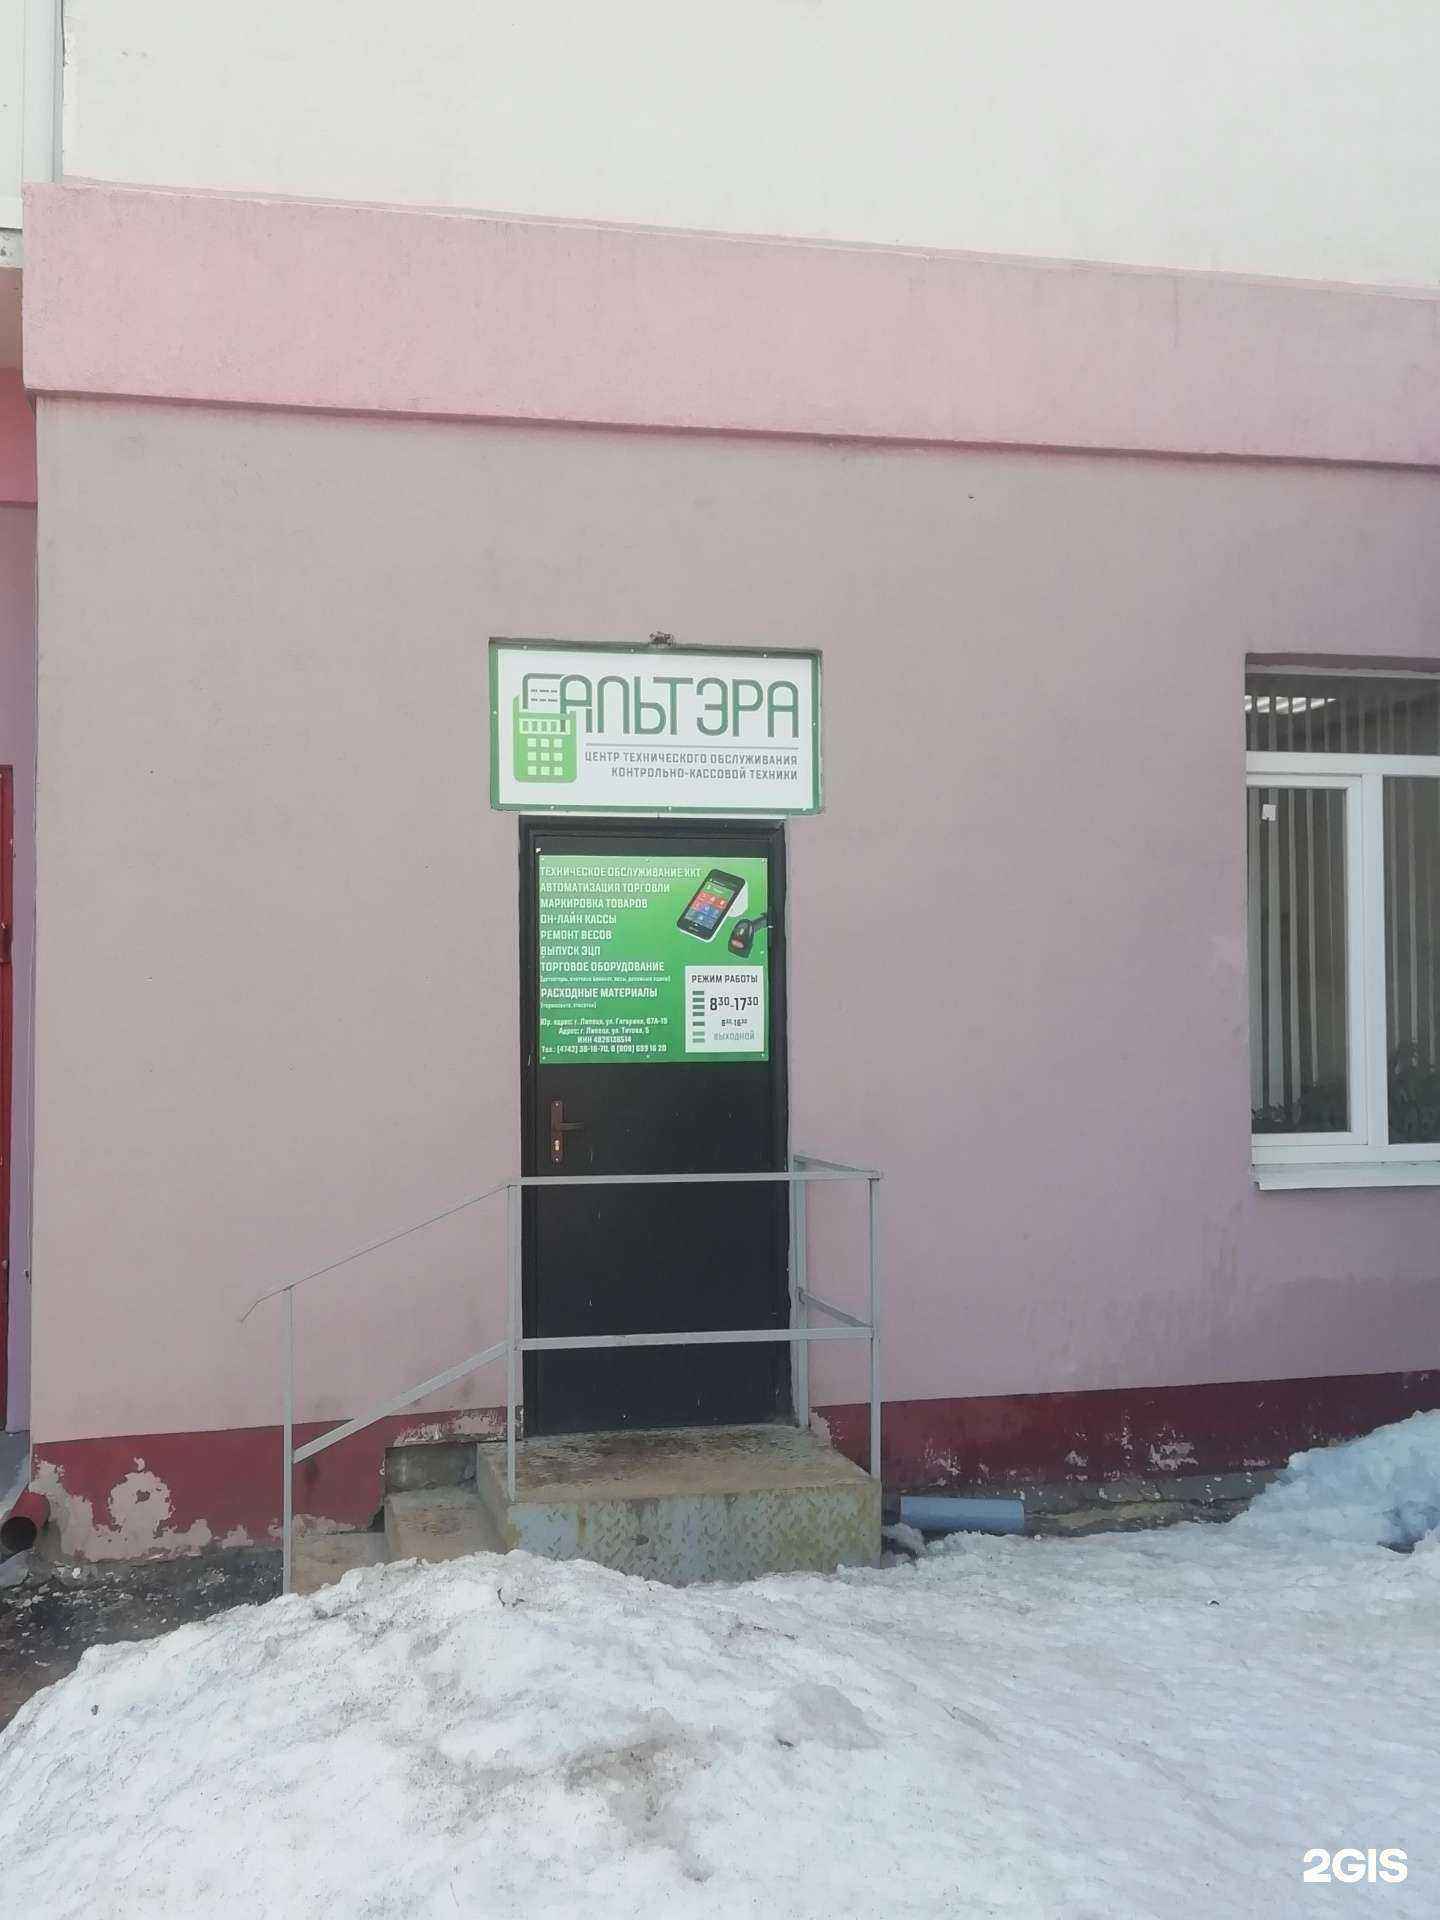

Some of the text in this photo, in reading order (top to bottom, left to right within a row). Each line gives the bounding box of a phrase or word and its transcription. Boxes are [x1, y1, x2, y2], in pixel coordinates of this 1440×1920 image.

[585, 751, 798, 765] ЦЕНТР ТЕХНИЧЕСКОГО ОБСЛУЖИВАНИЯ
[611, 766, 798, 780] КОНТРОЛЬНО-КАССОВОЙ ТЕХНИКИ
[540, 866, 701, 878] ТЕХНИЧЕСКОЕ ОБСЛУЖИВАНИЕ ККТ
[540, 883, 670, 893] АВТОМАТИЗАЦИЯ ТОРГОВЛИ
[540, 898, 648, 908] МАРКИРОВКА ТОВАРОВ
[540, 912, 617, 924] ОН-ЛАЙН КАССЫ
[540, 930, 612, 940] РЕМОНТ ВЕСОВ
[540, 946, 601, 956] ВЫПУСК ЭЦП
[540, 961, 665, 972] ТОРГОВОЕ ОБОРУДОВАНИЕ
[691, 974, 758, 984] РЕЖИМ РАБОТЫ
[541, 988, 658, 999] РАСХОДНЫЕ МАТЕРИАЛЫ
[713, 1030, 755, 1041] ВЫХОДНОЙ
